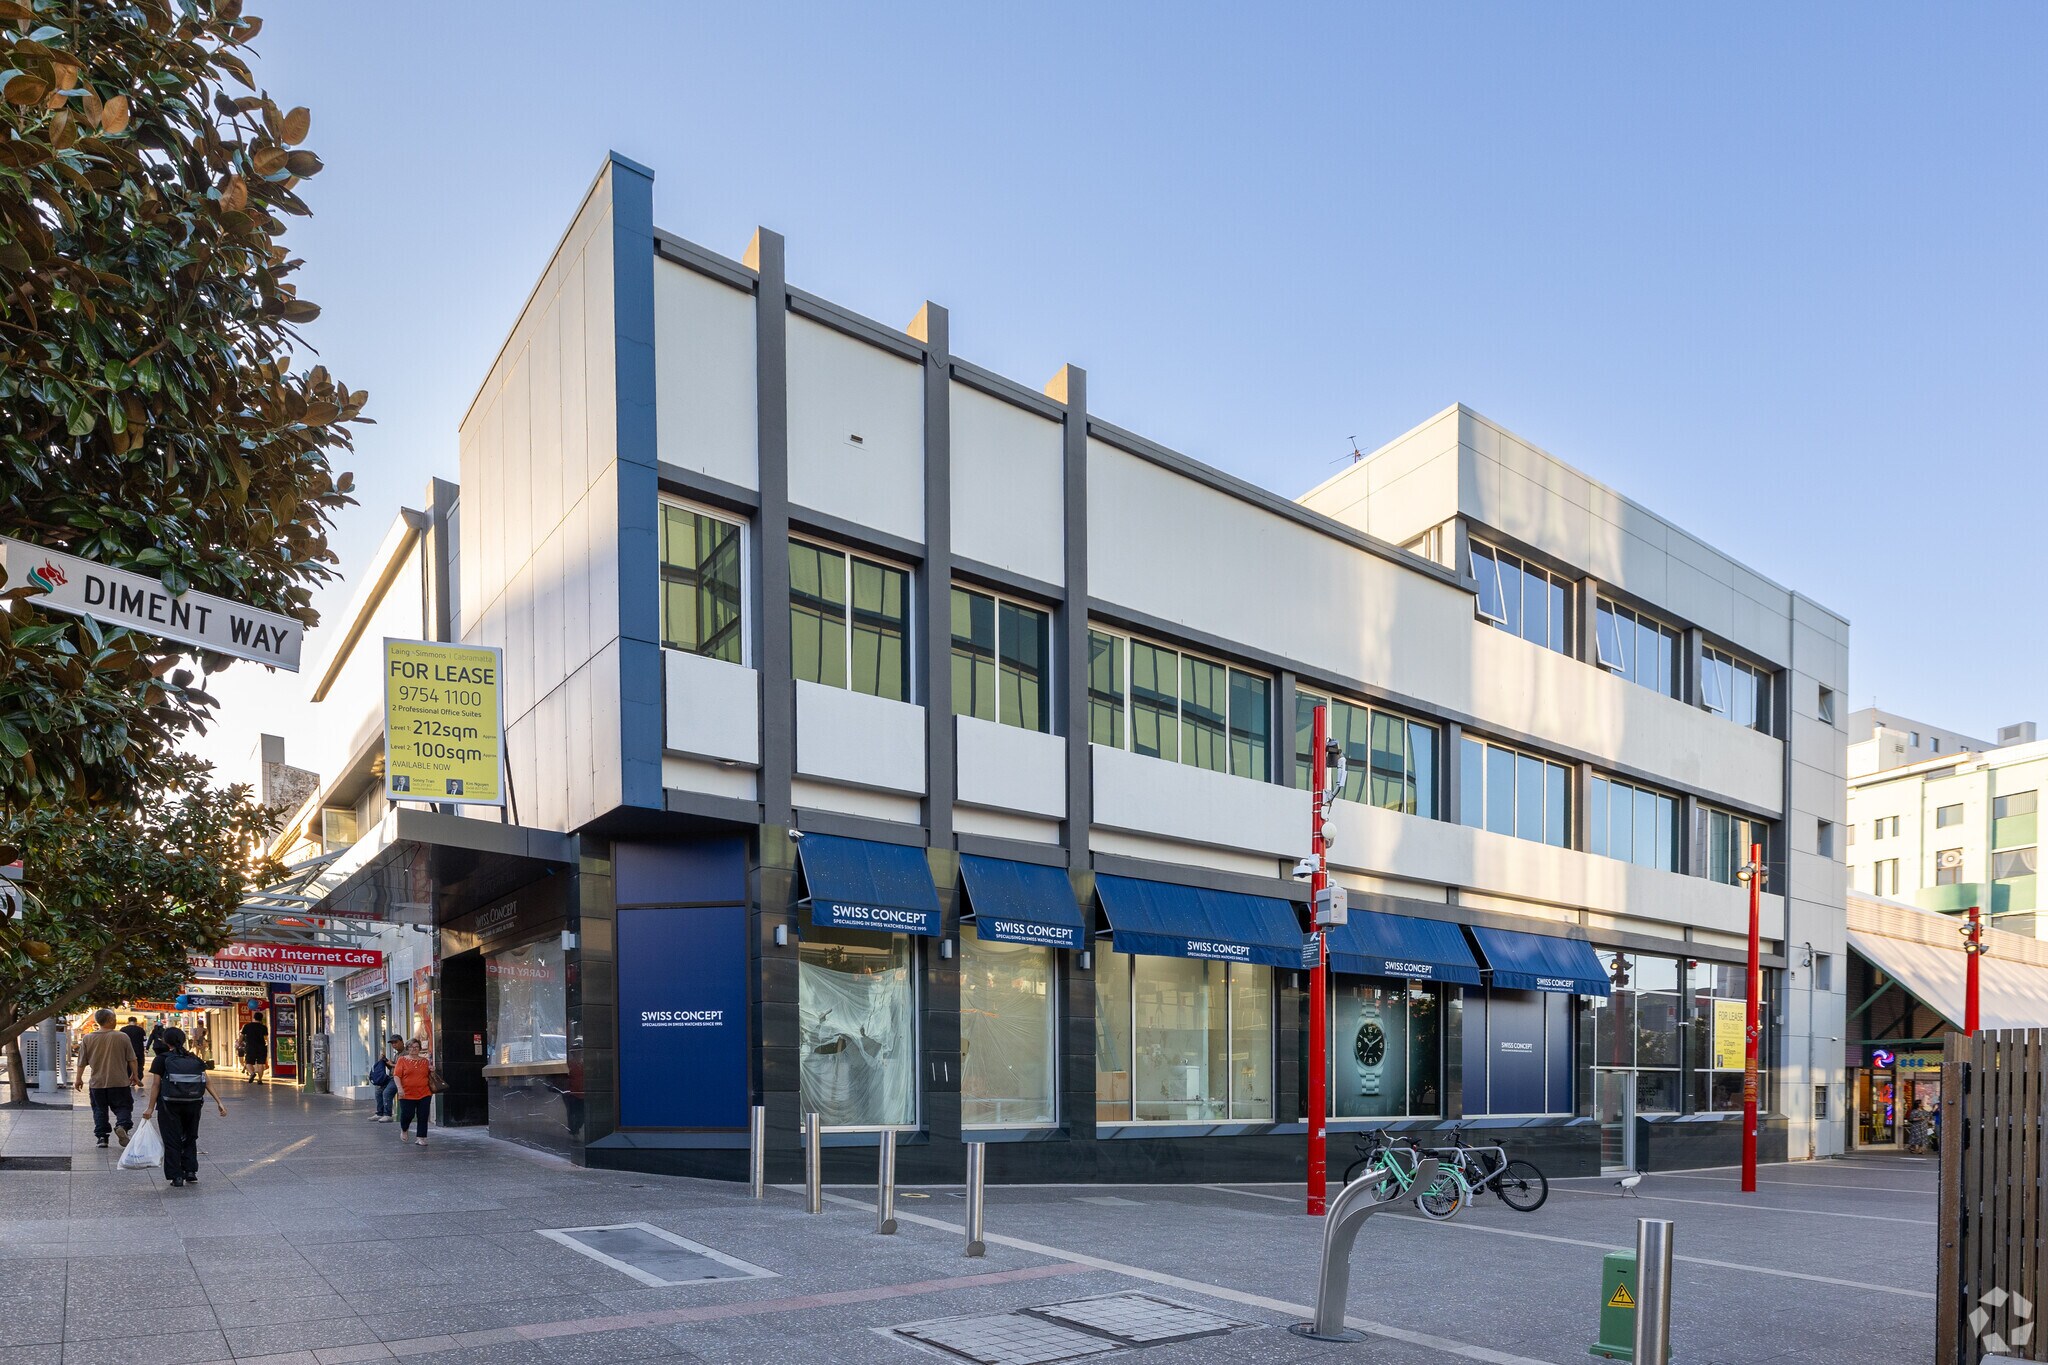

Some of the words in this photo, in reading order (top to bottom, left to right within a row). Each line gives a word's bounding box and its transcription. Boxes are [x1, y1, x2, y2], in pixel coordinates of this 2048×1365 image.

[84, 574, 212, 634] DIMENT
[230, 614, 289, 655] WAY
[391, 647, 410, 657] Laing
[415, 649, 447, 659] Simmons
[453, 653, 493, 663] Cabramatta
[391, 660, 429, 680] FOR
[435, 664, 495, 685] LEASE
[399, 685, 439, 703] 9754
[444, 689, 482, 706] 1100
[398, 704, 440, 715] Professional
[440, 708, 460, 717] Office
[461, 710, 482, 718] Suites
[413, 719, 478, 742] 212sqm
[413, 742, 482, 764] 100sqm
[392, 760, 431, 770] AVAILABLE
[433, 763, 451, 771] NOW
[832, 905, 869, 919] SWISS
[871, 909, 927, 924] CONCEPT
[995, 921, 1025, 934] SWISS
[1026, 925, 1074, 939] CONCEPT
[281, 948, 342, 962] Internet
[344, 952, 375, 964] Cafe
[1187, 940, 1212, 952] SWISS
[1212, 943, 1250, 956] CONCEPT
[188, 956, 209, 968] MY
[213, 960, 248, 970] HUNG
[251, 962, 325, 976] HURSTVILLE
[1384, 961, 1404, 971] SWISS
[1404, 963, 1432, 974] CONCEPT
[218, 970, 254, 979] FABRIC
[256, 972, 298, 982] FASHION
[641, 1012, 672, 1020] SWISS
[674, 1010, 724, 1020] CONCEPT
